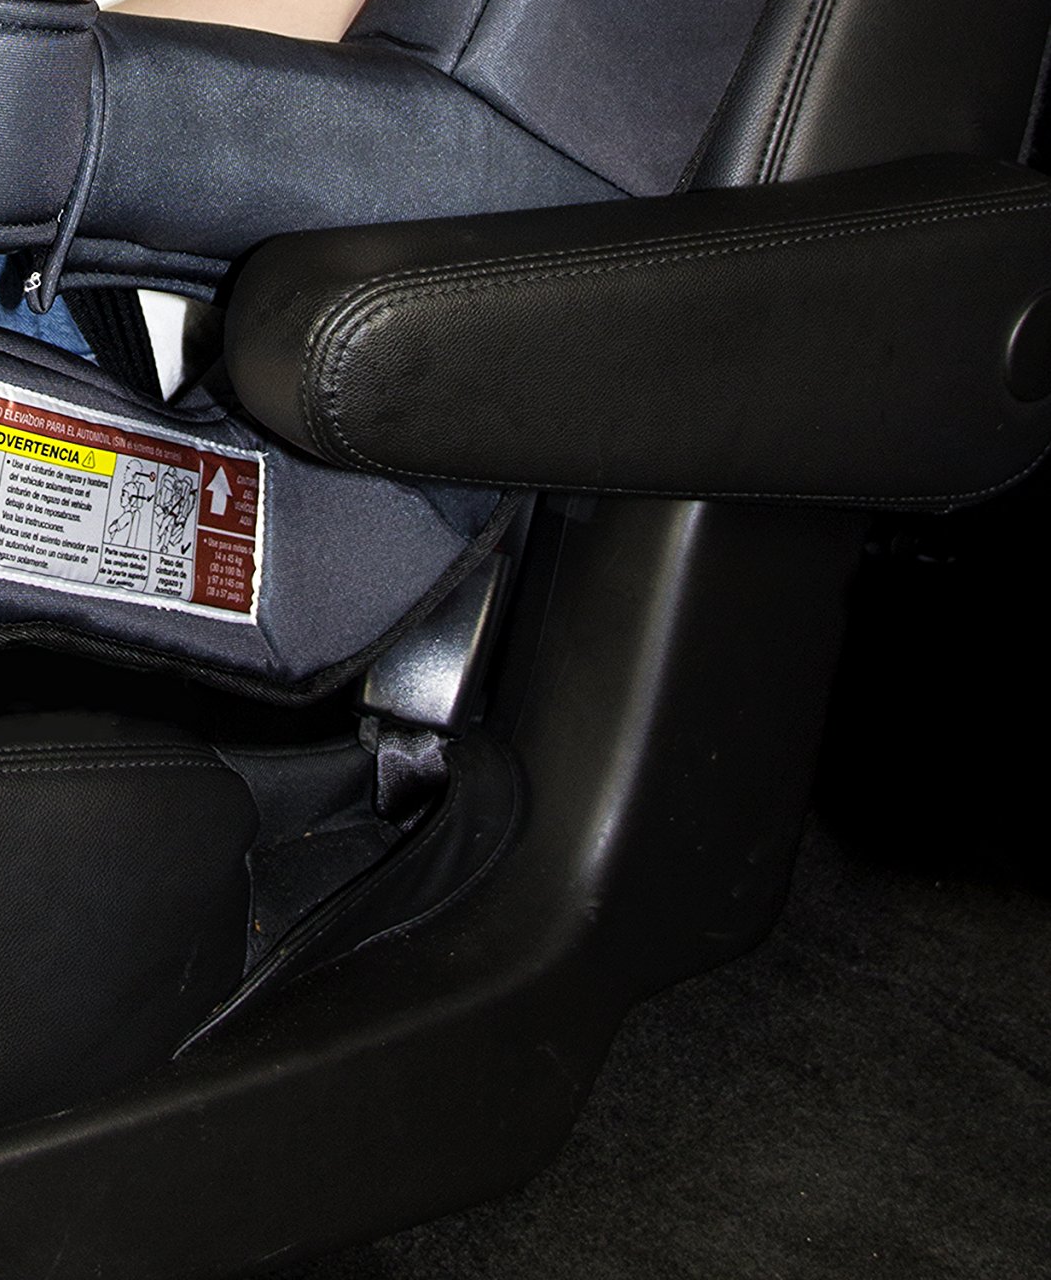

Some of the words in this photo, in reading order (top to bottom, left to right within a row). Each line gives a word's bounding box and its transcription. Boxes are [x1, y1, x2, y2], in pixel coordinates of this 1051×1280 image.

[4, 408, 45, 428] ELEVADOR
[45, 420, 65, 435] PARA
[67, 425, 75, 437] EL
[9, 472, 19, 481] del
[11, 460, 23, 469] Use
[31, 465, 55, 478] cinturón
[56, 470, 63, 479] de
[5, 498, 24, 510] debajo
[26, 502, 33, 511] de
[34, 504, 43, 514] los
[7, 485, 31, 497] cinturón
[32, 490, 40, 499] de
[61, 498, 69, 506] del
[2, 510, 14, 520] Vea
[15, 514, 23, 523] las
[25, 515, 64, 533] instrucciones.
[0, 524, 19, 536] Nunca
[20, 530, 31, 539] use
[33, 532, 38, 540] el
[39, 534, 61, 546] asiento
[86, 544, 99, 554] para
[5, 539, 35, 553] automóvil
[36, 547, 47, 555] con
[48, 549, 56, 557] un
[81, 555, 88, 564] de
[214, 552, 222, 560] 14
